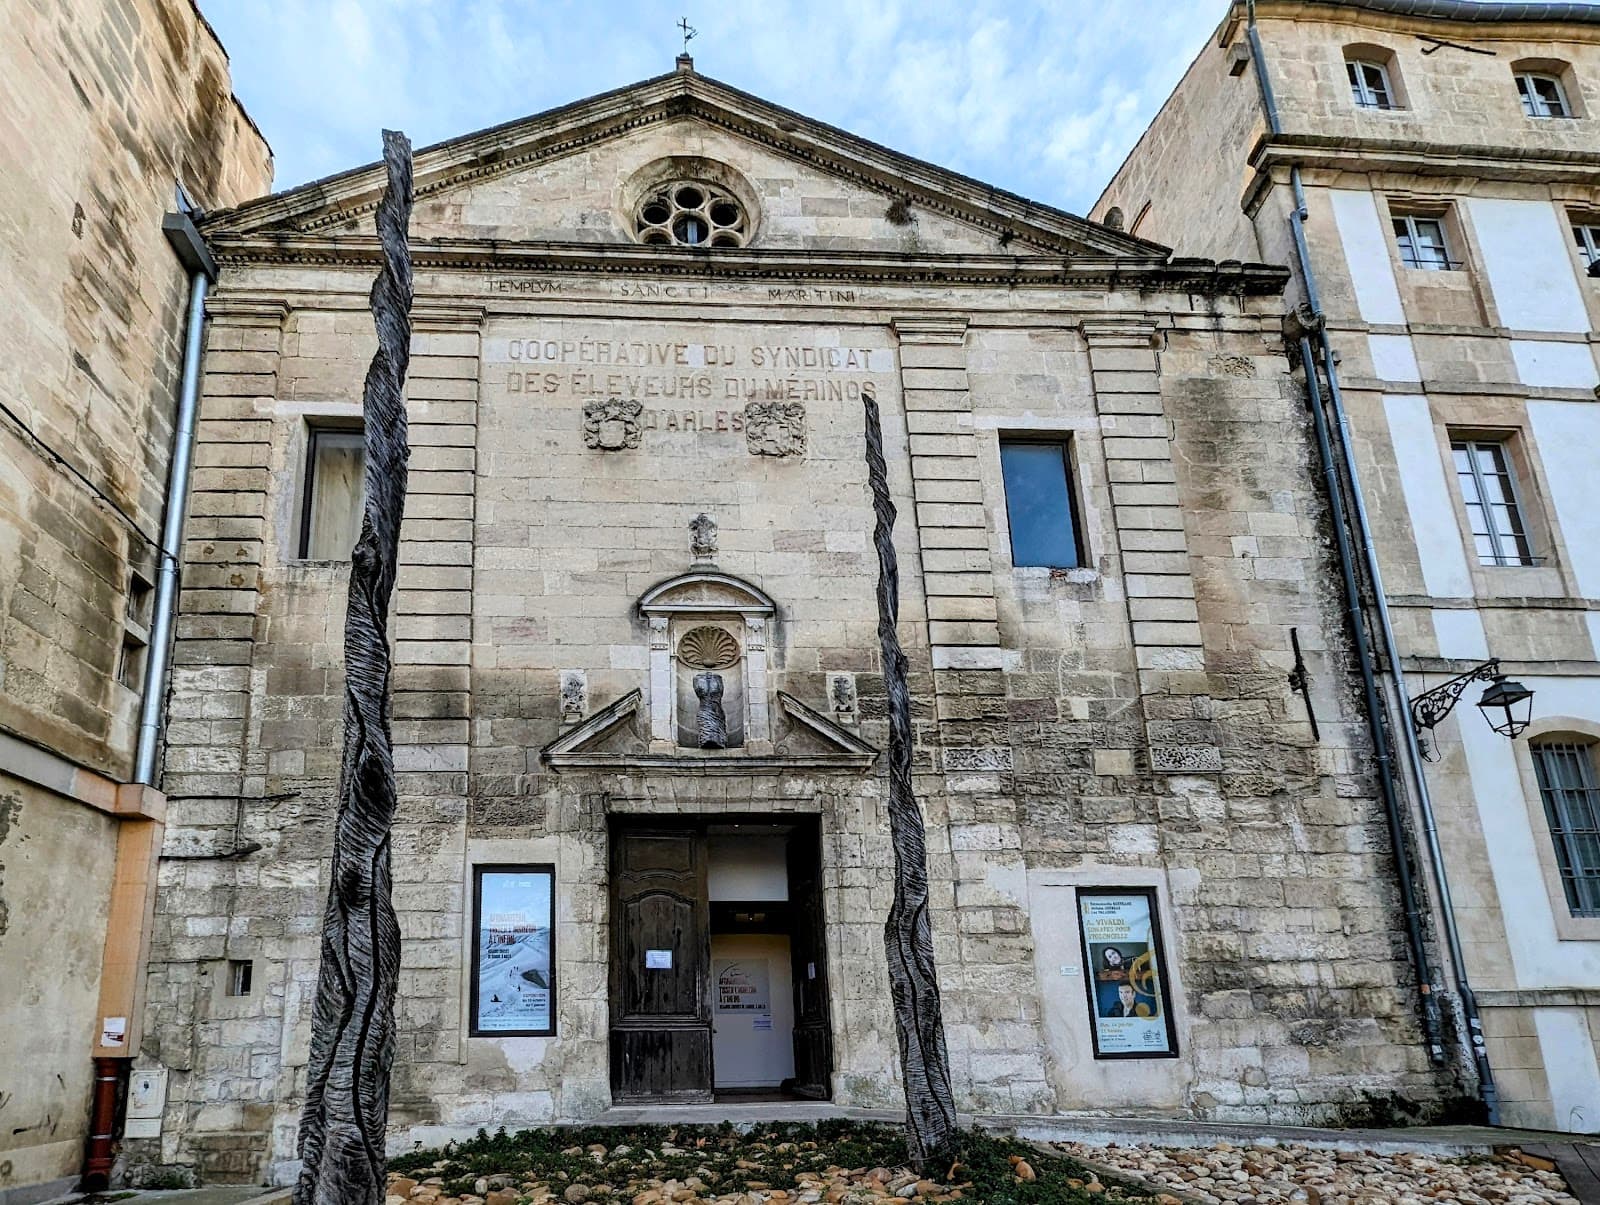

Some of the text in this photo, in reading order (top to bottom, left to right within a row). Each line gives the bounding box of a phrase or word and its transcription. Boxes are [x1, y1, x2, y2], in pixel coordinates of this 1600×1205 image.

[485, 280, 855, 302] TEMPLVM SANCTI MARTINI
[508, 335, 873, 369] COOPÉRATIVE DU SYNDICAT
[506, 371, 561, 393] DES
[724, 378, 756, 399] DU
[765, 373, 876, 401] MÉRINOS
[643, 408, 744, 433] D'ARLES
[1095, 918, 1125, 926] VIVALDI
